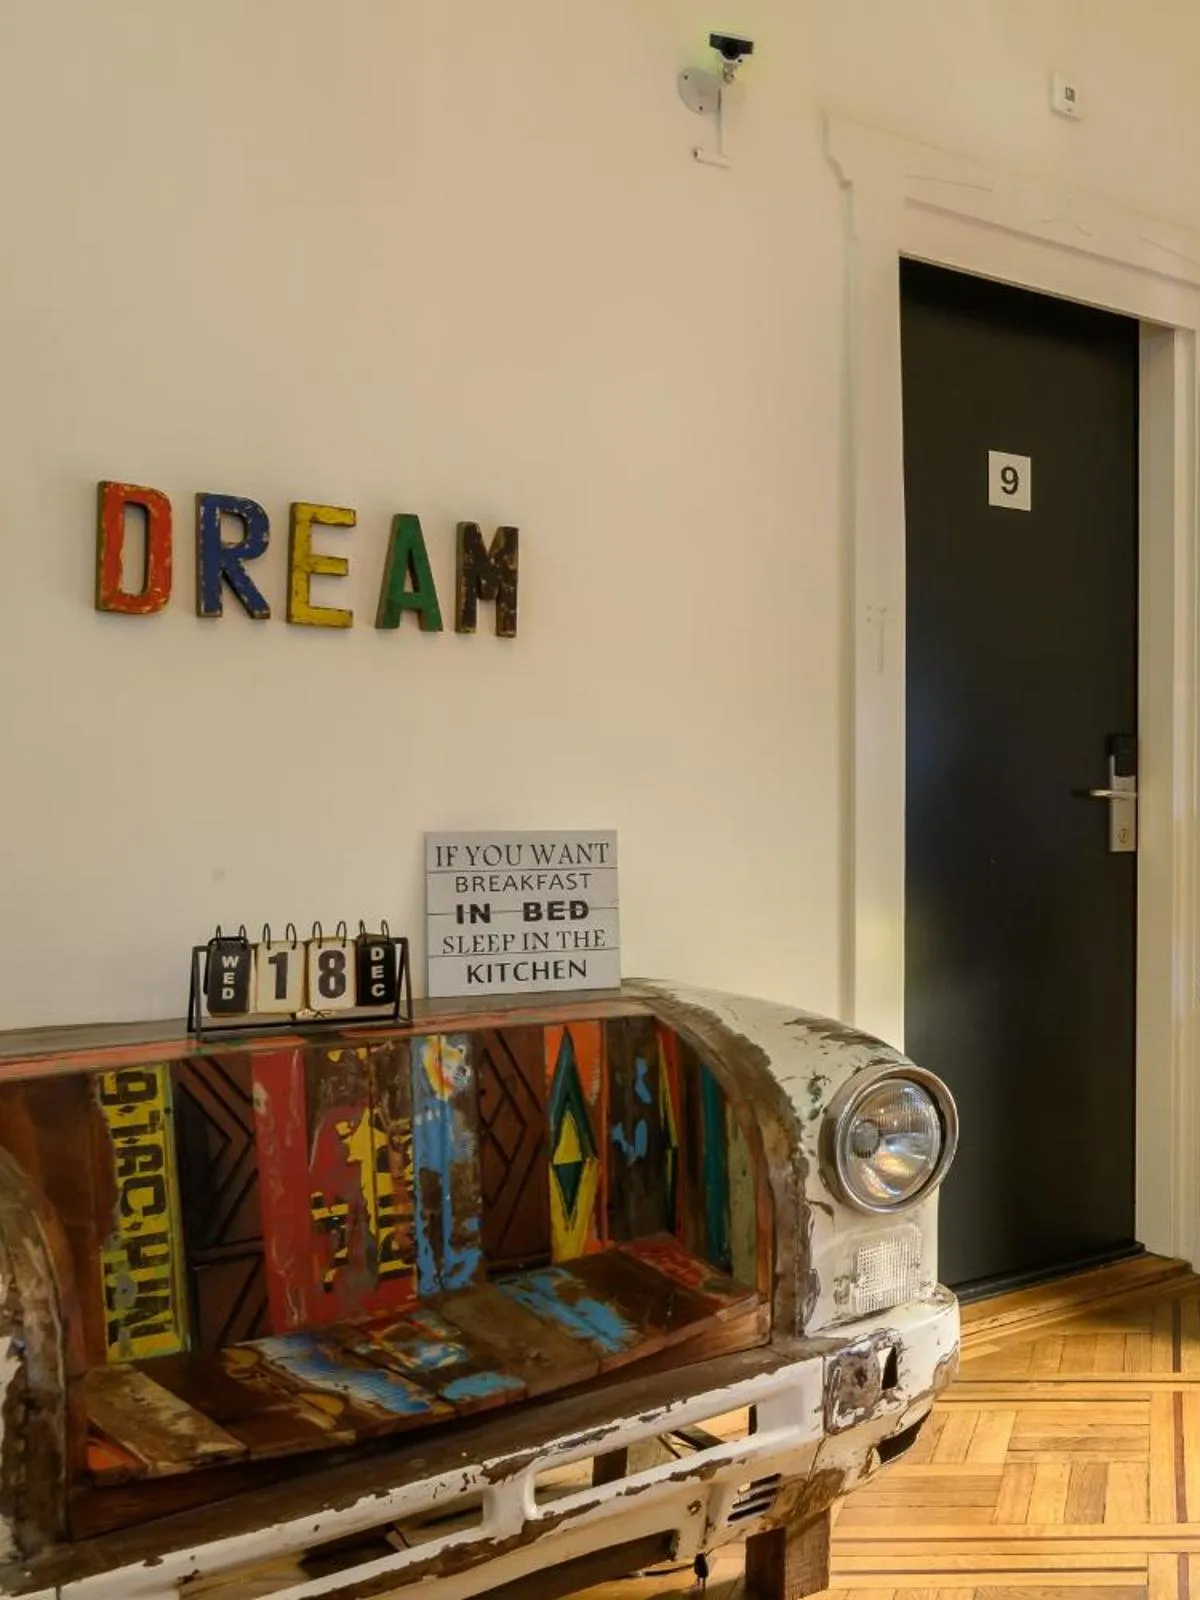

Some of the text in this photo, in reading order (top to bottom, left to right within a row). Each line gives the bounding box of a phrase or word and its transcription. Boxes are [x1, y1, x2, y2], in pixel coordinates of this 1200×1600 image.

[1001, 466, 1019, 495] 9
[96, 479, 519, 639] DREAM
[435, 842, 609, 867] IF YOU WANT
[455, 873, 592, 893] BREAKFAST
[456, 900, 589, 924] IN BED
[442, 928, 606, 954] SLEEP IN THE
[221, 955, 240, 1000] WED
[370, 946, 386, 998] DEC
[467, 959, 588, 984] KITCHEN
